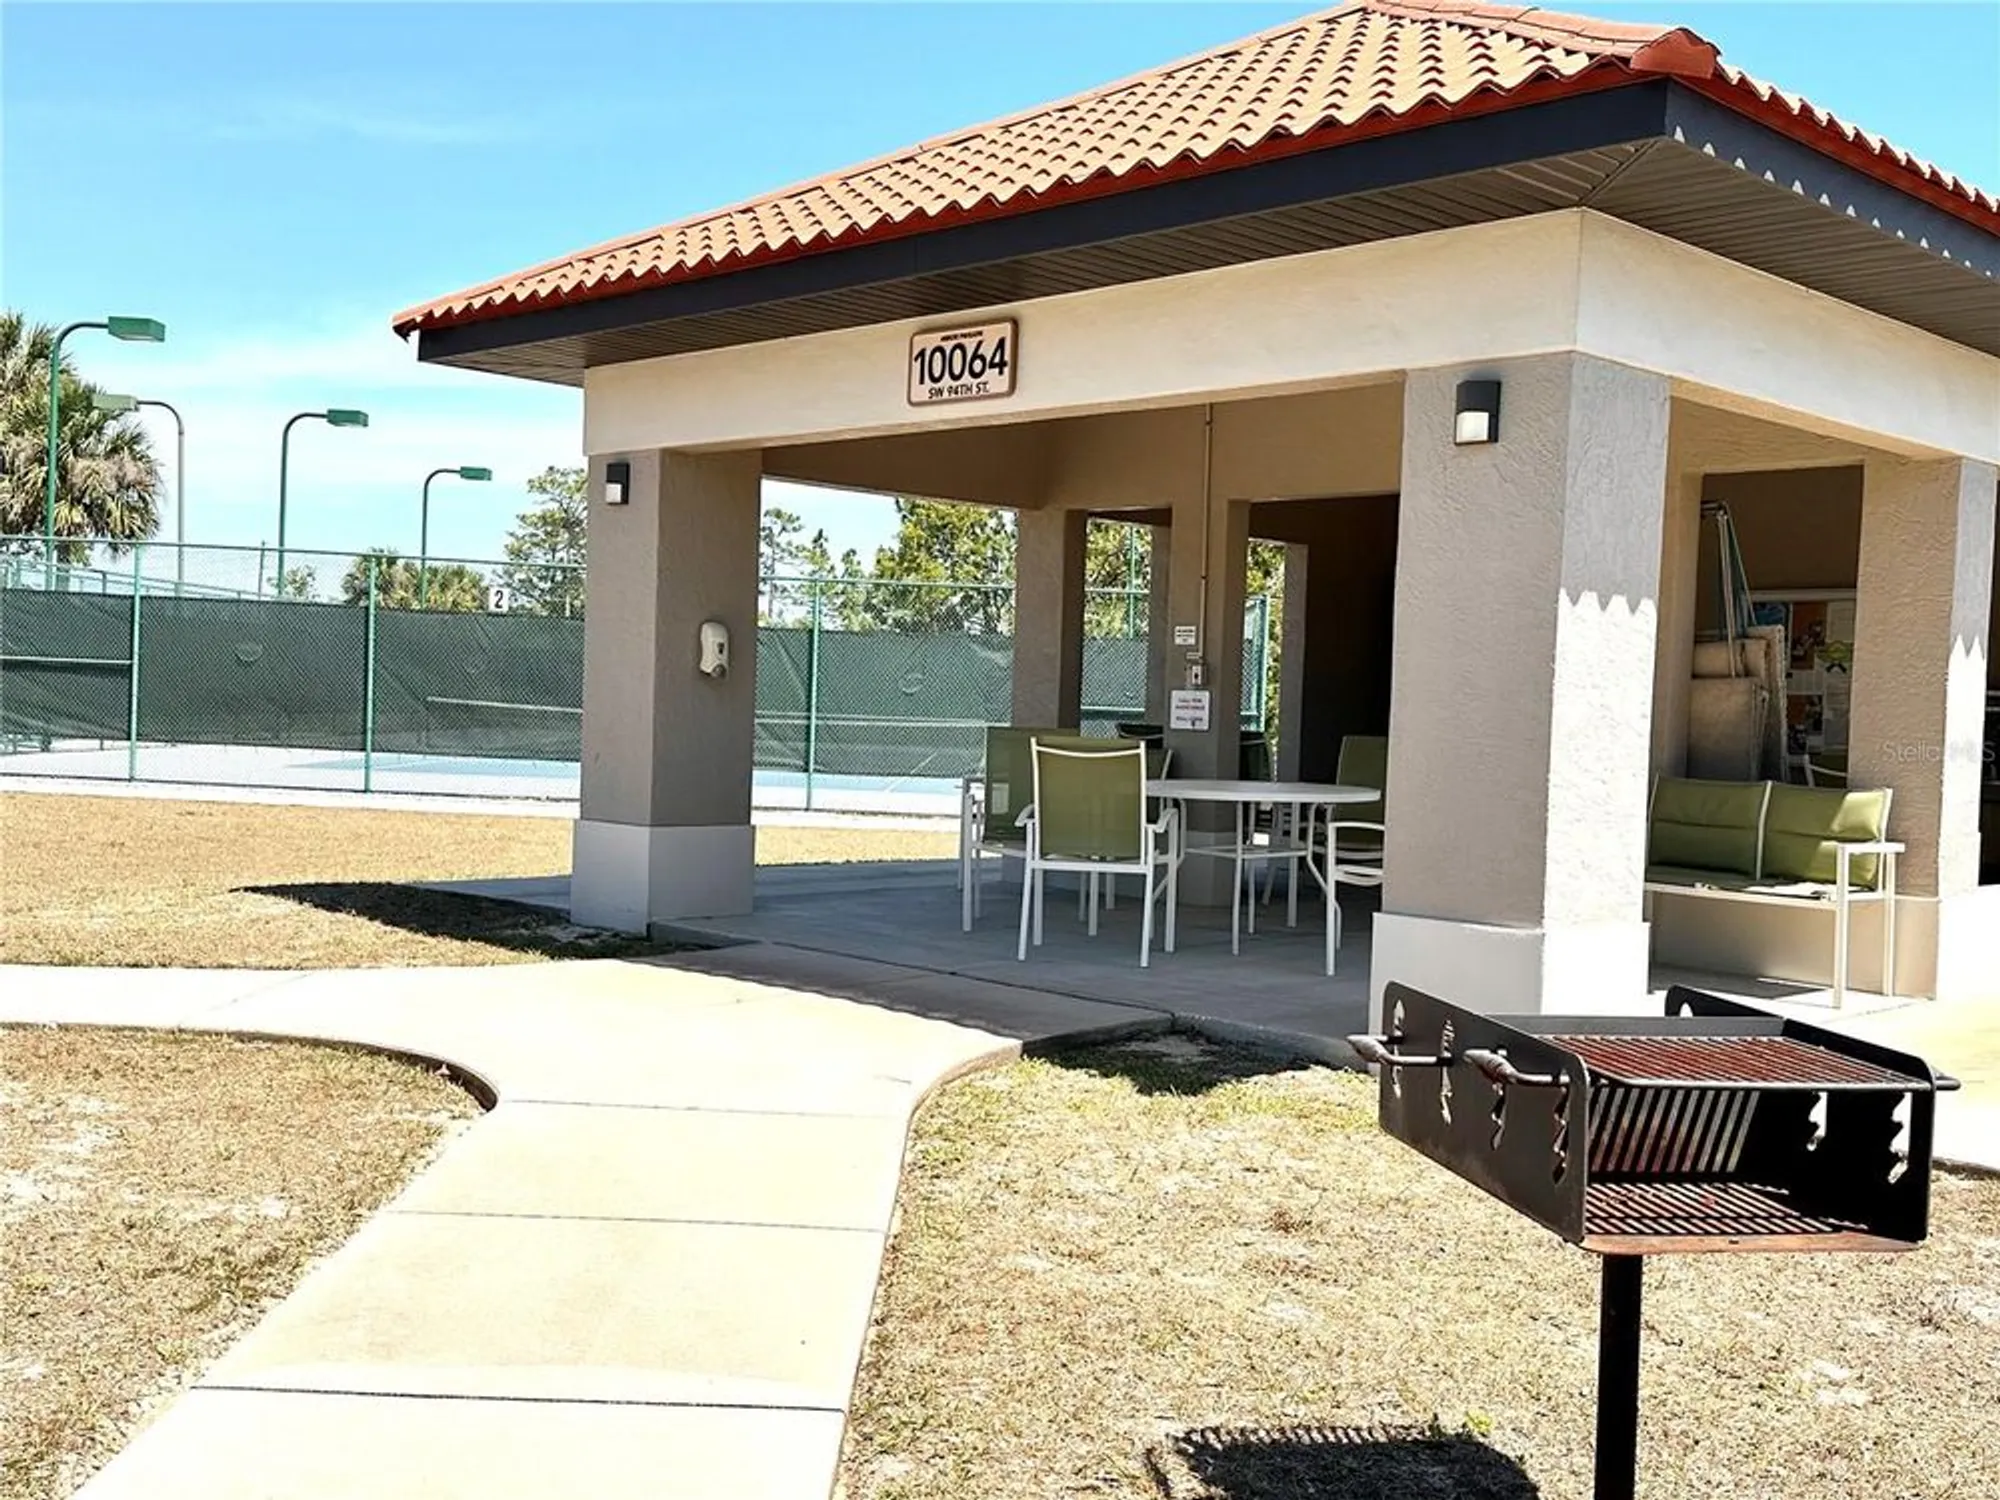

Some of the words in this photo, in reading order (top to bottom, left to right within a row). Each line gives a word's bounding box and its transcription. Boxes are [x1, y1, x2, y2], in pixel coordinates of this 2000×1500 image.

[914, 336, 1008, 385] 10064
[928, 386, 945, 399] SW
[947, 383, 974, 397] 94TH
[494, 589, 504, 609] 2
